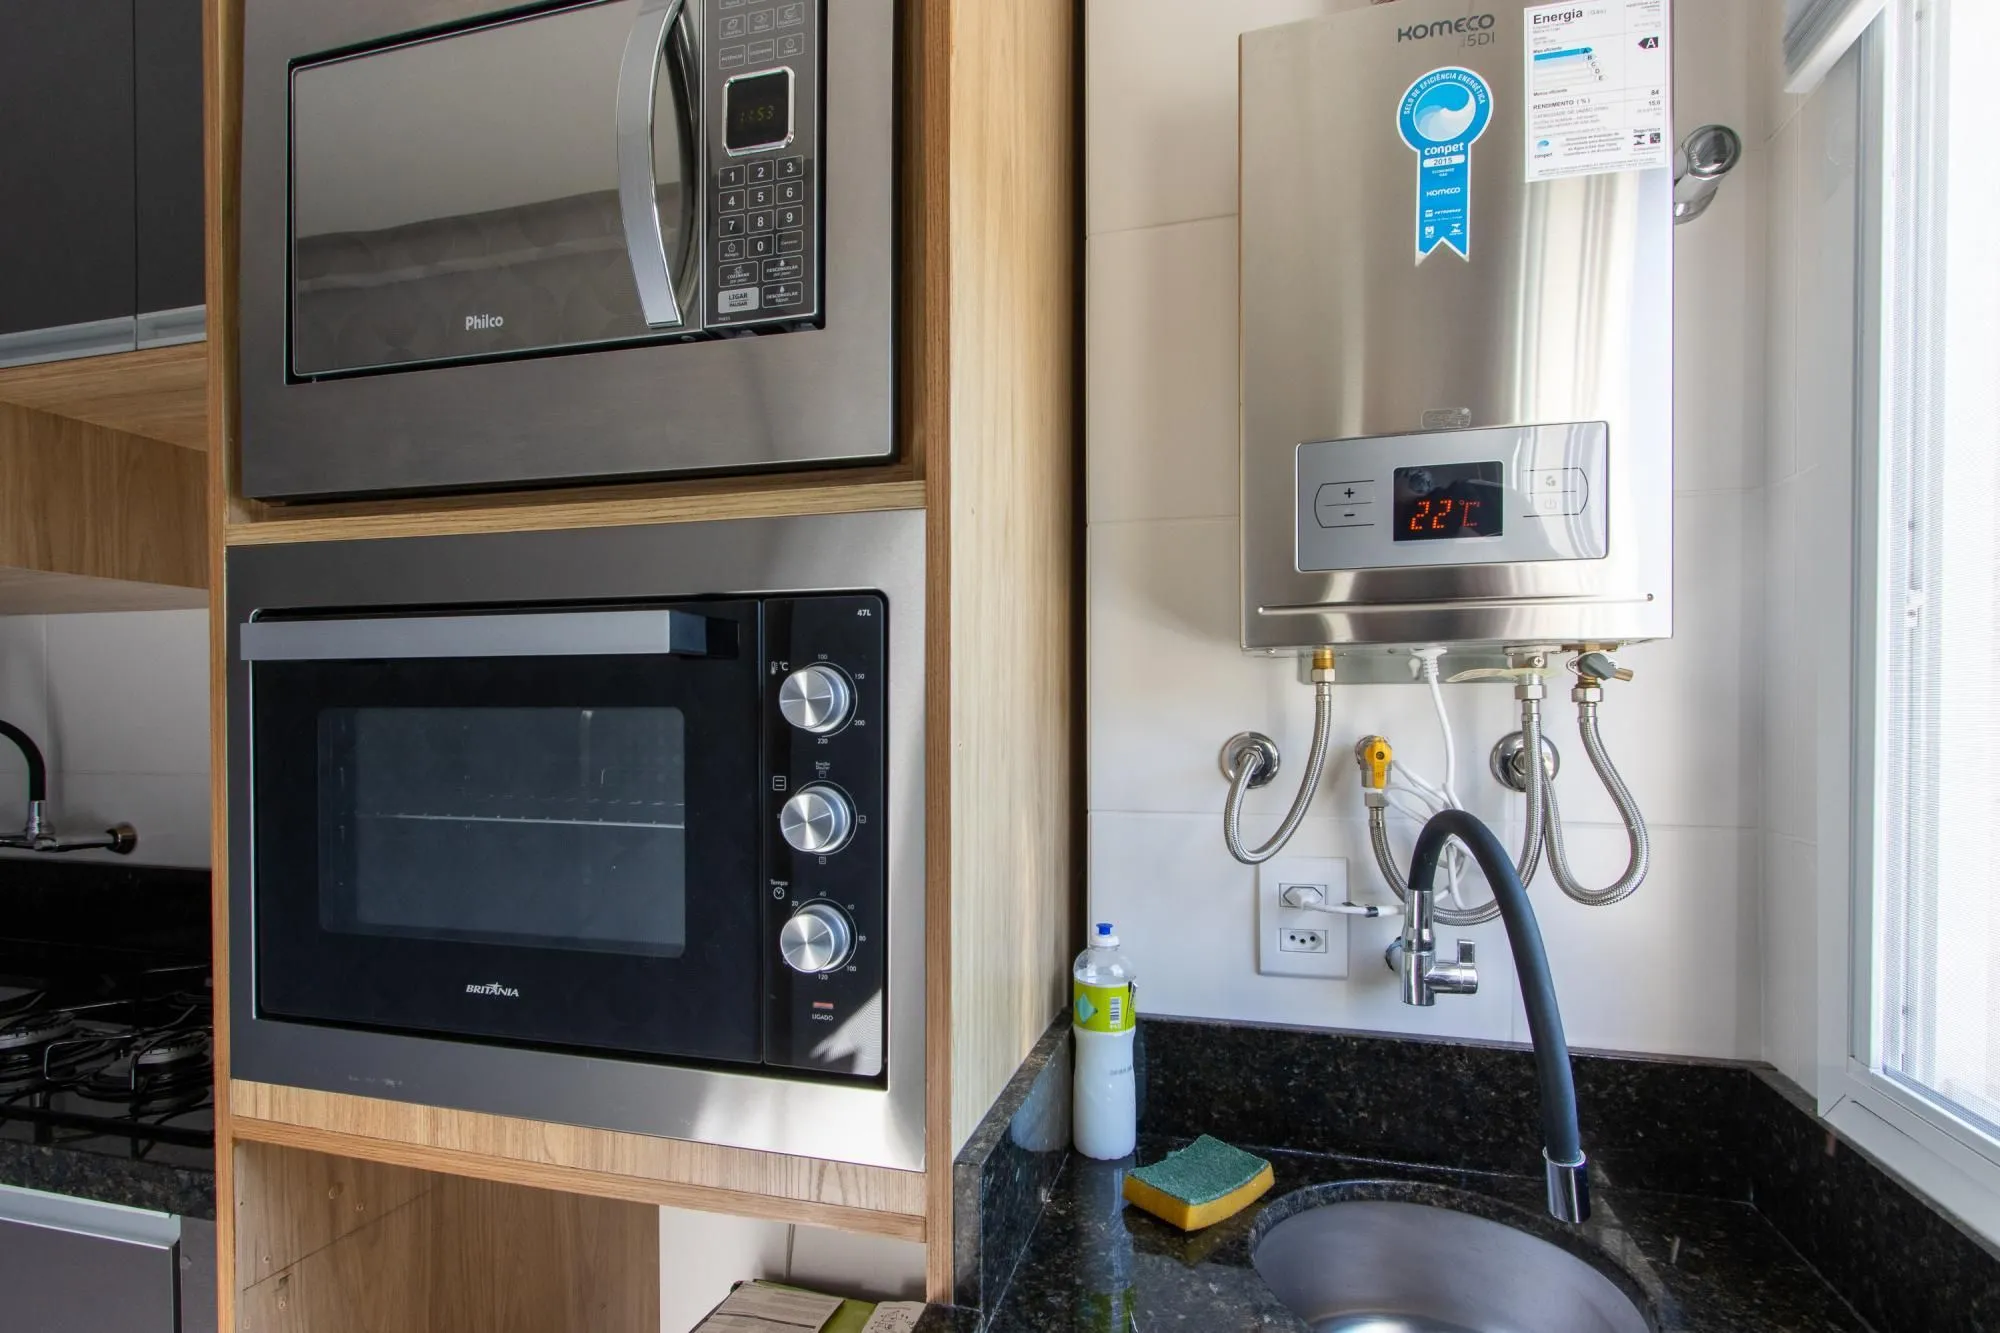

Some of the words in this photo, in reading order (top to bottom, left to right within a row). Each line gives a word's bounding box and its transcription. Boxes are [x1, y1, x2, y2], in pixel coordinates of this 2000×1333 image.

[1533, 8, 1583, 24] Energia
[1397, 14, 1495, 43] KOMECO
[1646, 38, 1657, 49] A
[1404, 98, 1414, 115] SELO
[1412, 89, 1420, 98] DE
[1420, 72, 1457, 90] EFICIÊNCIA
[1458, 74, 1486, 105] ENERGÉTICA
[1533, 100, 1574, 110] RENDIMENTO
[1424, 142, 1464, 155] conpet
[1433, 157, 1453, 165] 2015
[757, 167, 764, 178] 2
[786, 162, 793, 173] 3
[730, 171, 735, 182] 1
[757, 192, 764, 202] 5
[786, 187, 793, 198] 6
[728, 196, 735, 206] 4
[757, 216, 764, 227] 8
[786, 212, 793, 223] 9
[728, 221, 735, 231] 7
[757, 241, 764, 252] 0
[729, 292, 747, 300] LIGAR
[465, 314, 504, 331] Philco
[857, 609, 871, 617] 47L
[812, 1013, 834, 1021] LIGADO
